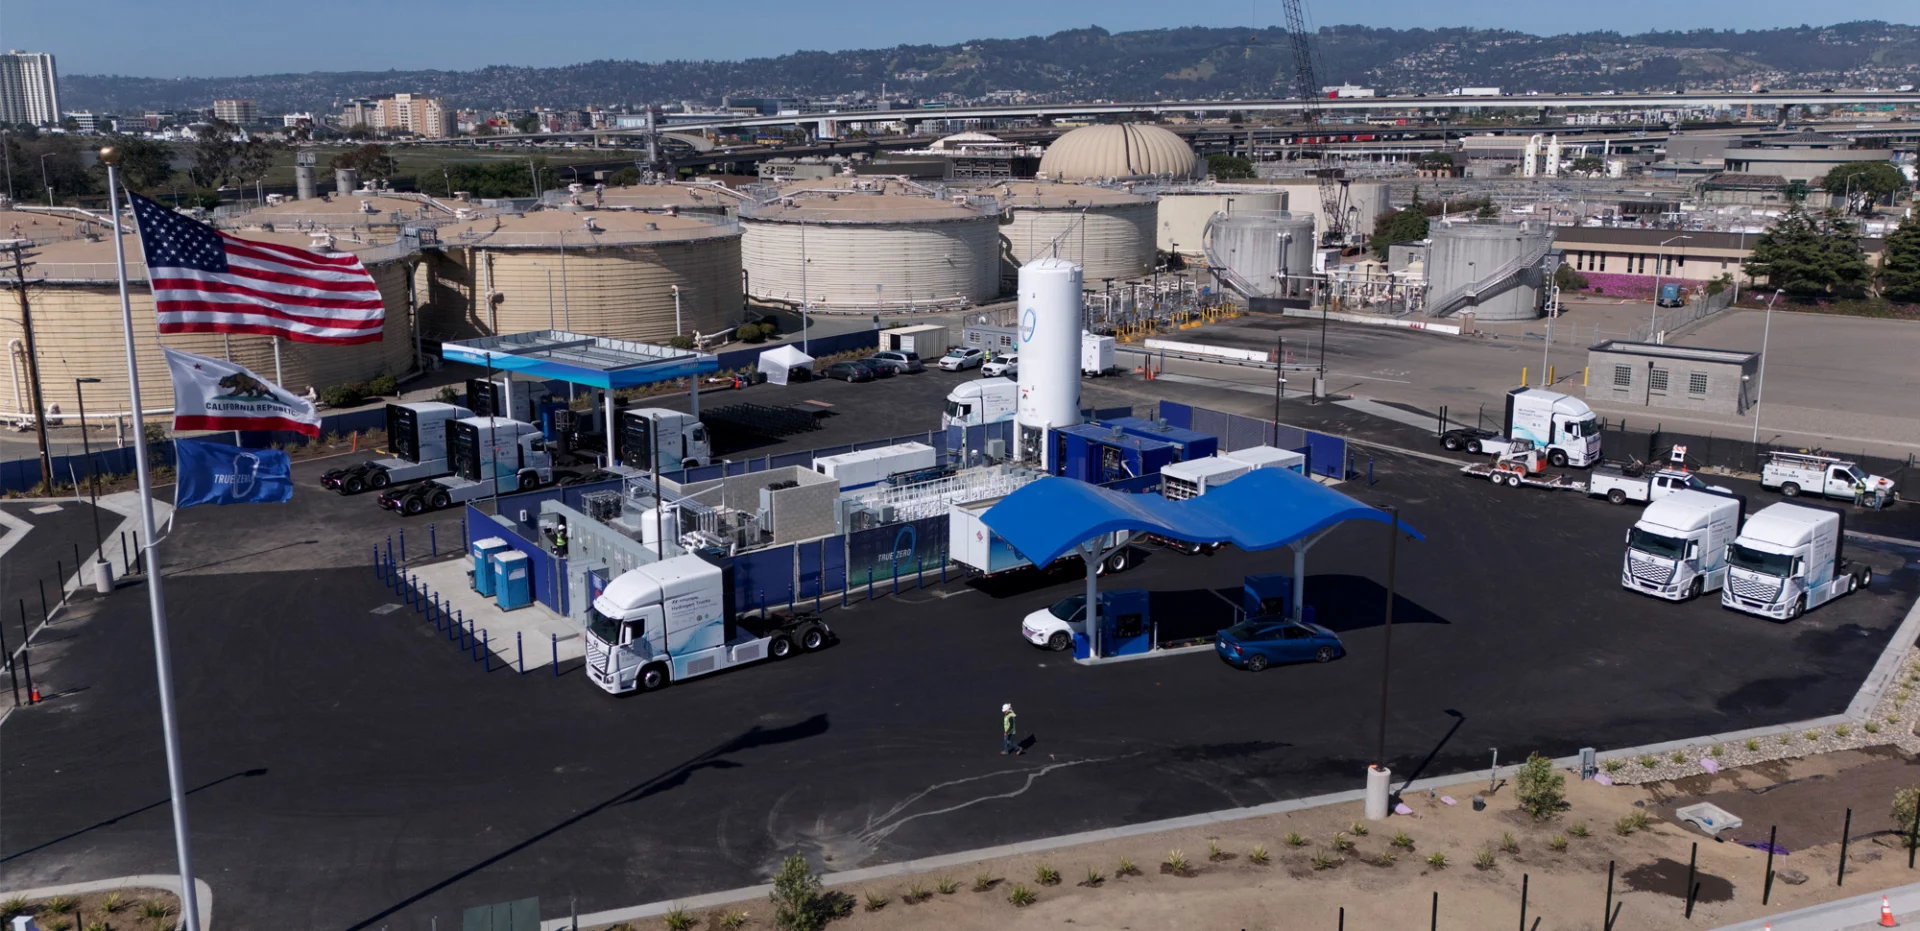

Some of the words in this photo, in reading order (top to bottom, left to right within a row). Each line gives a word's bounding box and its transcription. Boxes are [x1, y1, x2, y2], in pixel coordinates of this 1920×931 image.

[205, 402, 256, 412] CALIFORNIA
[256, 404, 296, 416] REPUBLIC
[214, 473, 236, 484] TRUE
[878, 551, 894, 562] TRUE
[895, 548, 912, 559] ZERO
[671, 602, 695, 611] Hydrogen
